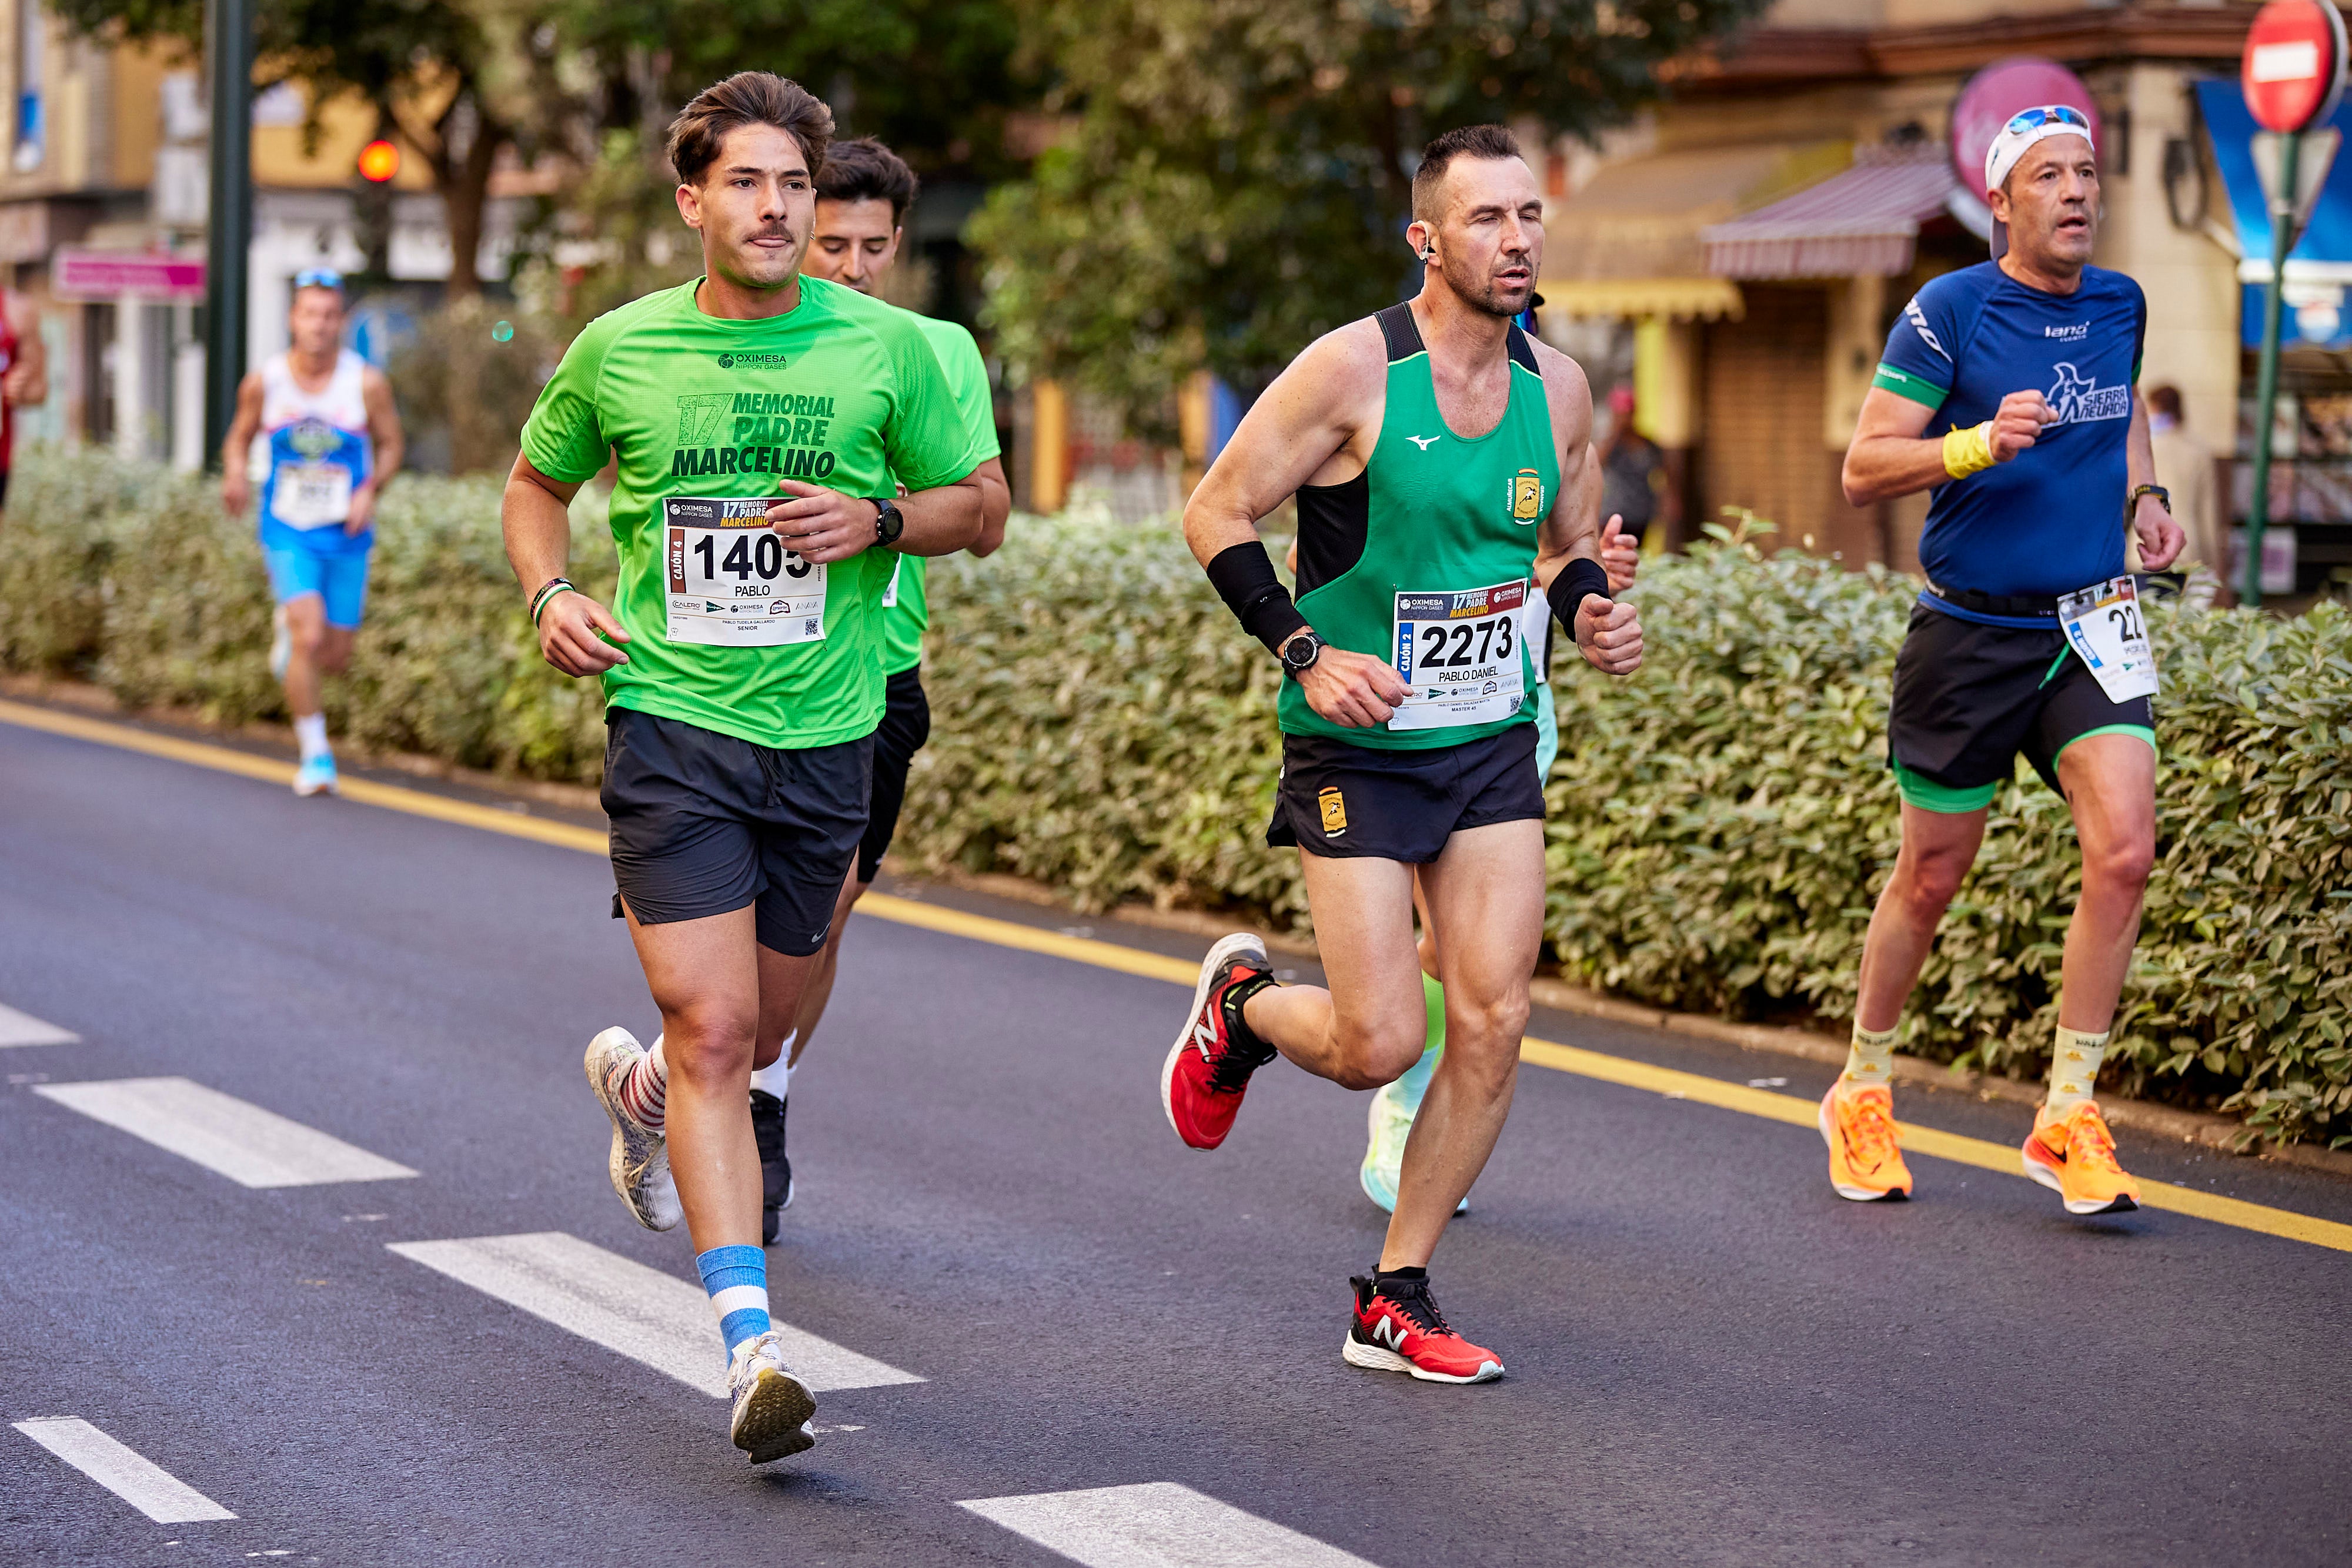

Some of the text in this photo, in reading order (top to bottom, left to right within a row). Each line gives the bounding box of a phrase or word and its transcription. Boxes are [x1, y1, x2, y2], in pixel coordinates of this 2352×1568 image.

[736, 354, 786, 363] OXIMESA
[2084, 389, 2124, 405] SIERRA
[677, 393, 835, 446] 17 MEMORIAL
[733, 416, 829, 447] PADRE
[671, 447, 835, 478] MARCELINO
[681, 504, 713, 513] OXIMESA
[723, 502, 740, 517] 17
[739, 507, 766, 517] PADRE
[720, 516, 769, 527] MARCELINO
[673, 550, 683, 580] CAJÓN
[735, 585, 770, 597] PABLO
[1501, 587, 1522, 597] OXIMESA
[796, 601, 818, 610] ANAYA
[1452, 590, 1489, 609] 17 MEMORIAL
[1466, 597, 1487, 609] PADRE
[1449, 605, 1489, 618] MARCELINO
[1419, 616, 1512, 668] 2273
[1401, 641, 1411, 671] CAJÓN
[1439, 666, 1498, 682] PABLO DANIEL
